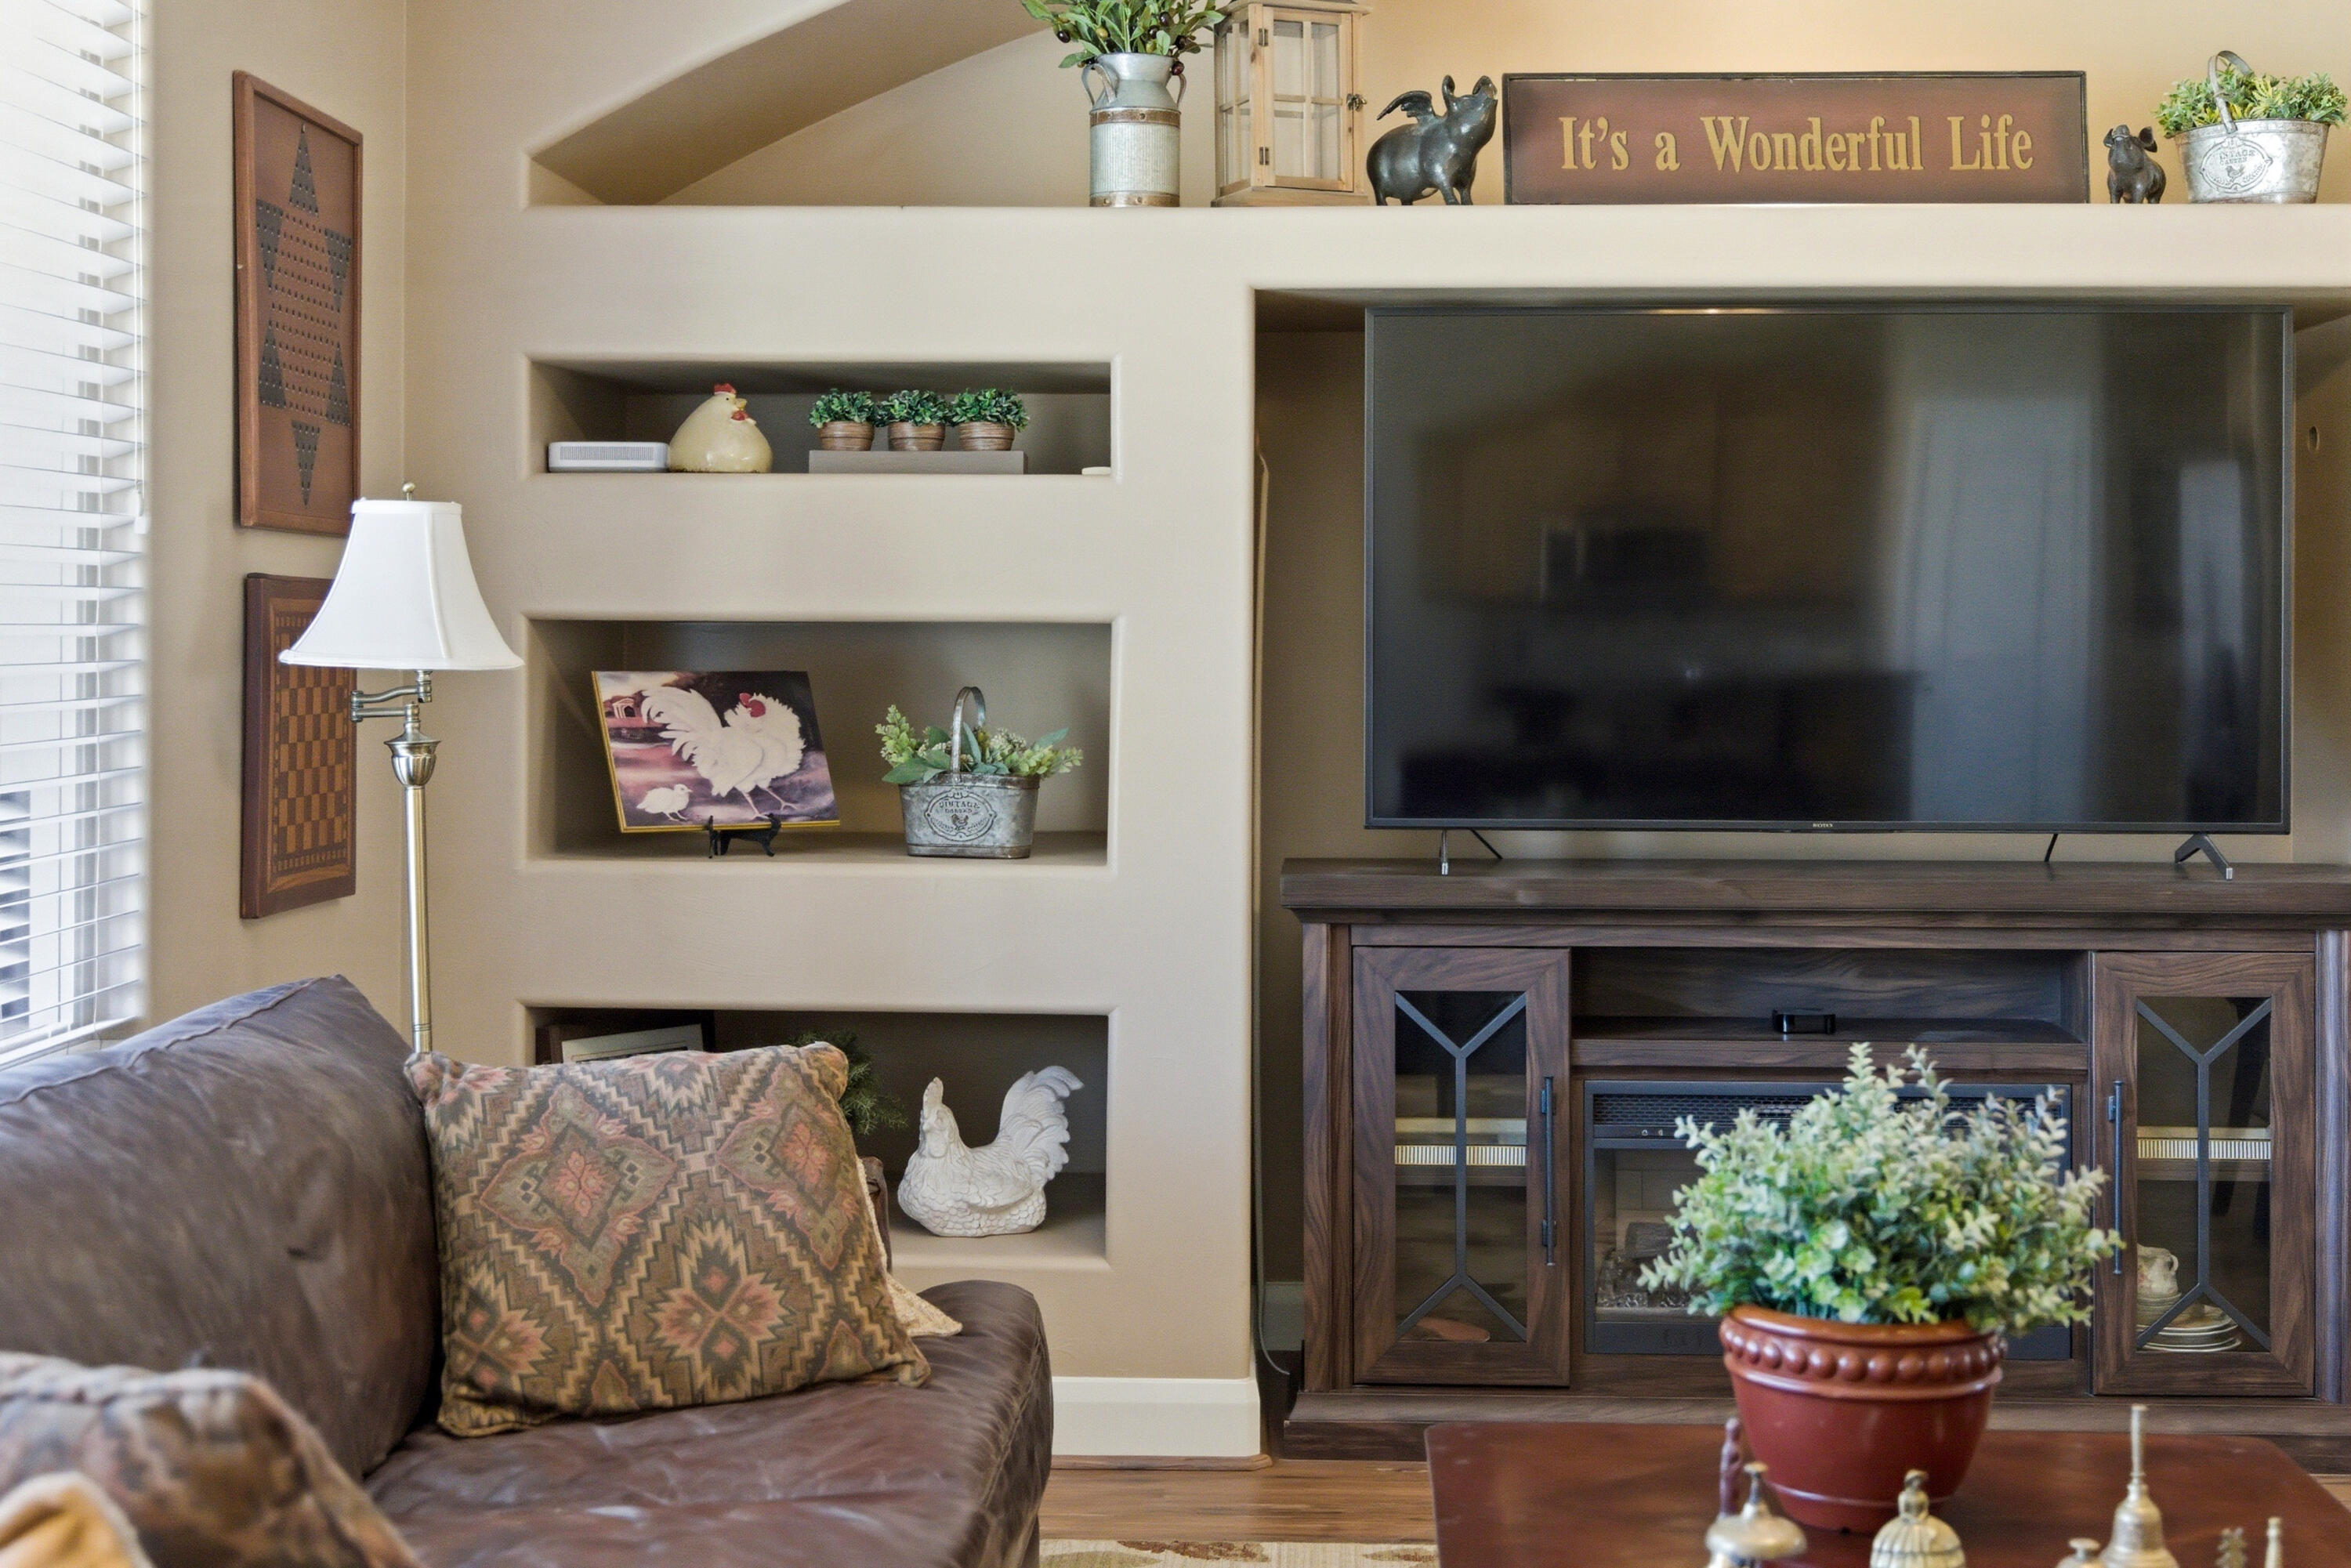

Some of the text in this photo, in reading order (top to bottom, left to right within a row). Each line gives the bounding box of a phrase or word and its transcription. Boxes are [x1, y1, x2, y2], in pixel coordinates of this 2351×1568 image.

[1558, 114, 2034, 173] It's a Wonderful Life
